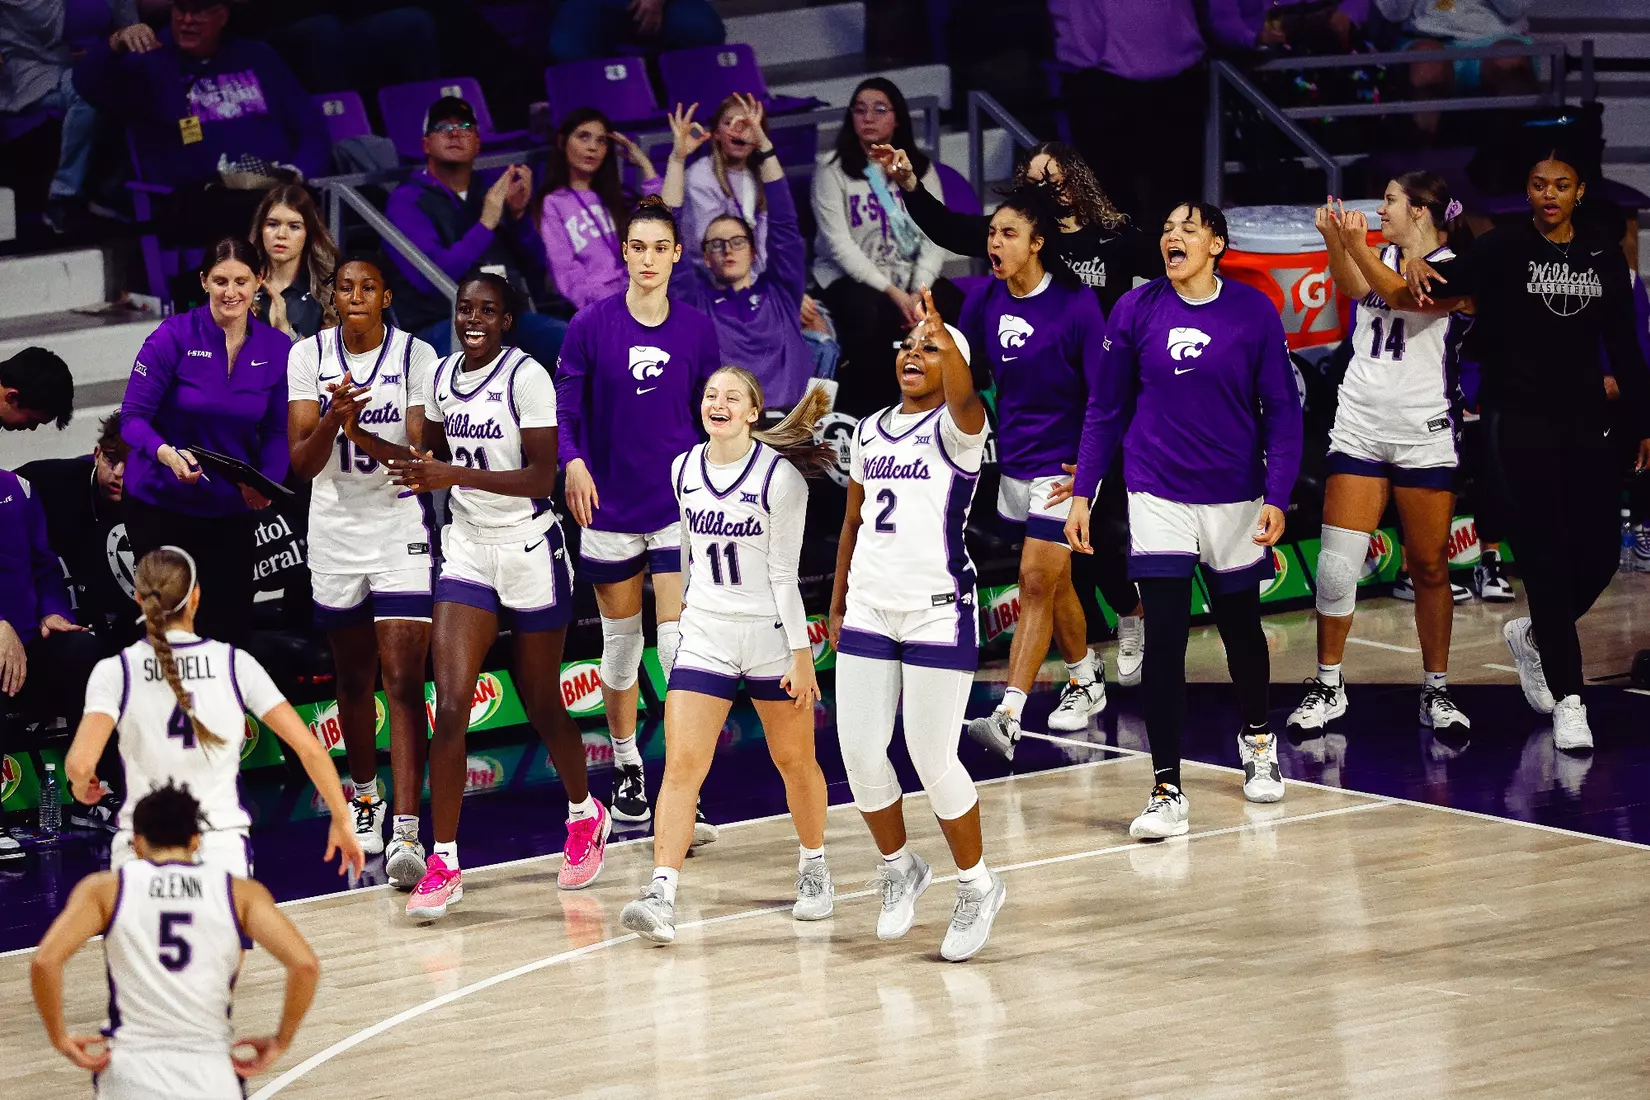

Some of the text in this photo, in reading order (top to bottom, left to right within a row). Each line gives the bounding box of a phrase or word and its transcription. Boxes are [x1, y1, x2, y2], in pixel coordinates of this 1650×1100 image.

[1528, 261, 1601, 286] Wildcats
[1300, 272, 1326, 309] G
[1529, 283, 1601, 297] BASKETBALL
[1371, 316, 1405, 361] 14
[863, 455, 931, 480] Wildcats
[740, 490, 760, 505] XII
[875, 488, 898, 533] 2
[685, 507, 764, 537] Wildcats
[706, 542, 742, 586] 11
[144, 655, 216, 681] SUDELL
[167, 692, 197, 749] 4
[148, 873, 203, 899] GLENN
[159, 912, 193, 973] 5
